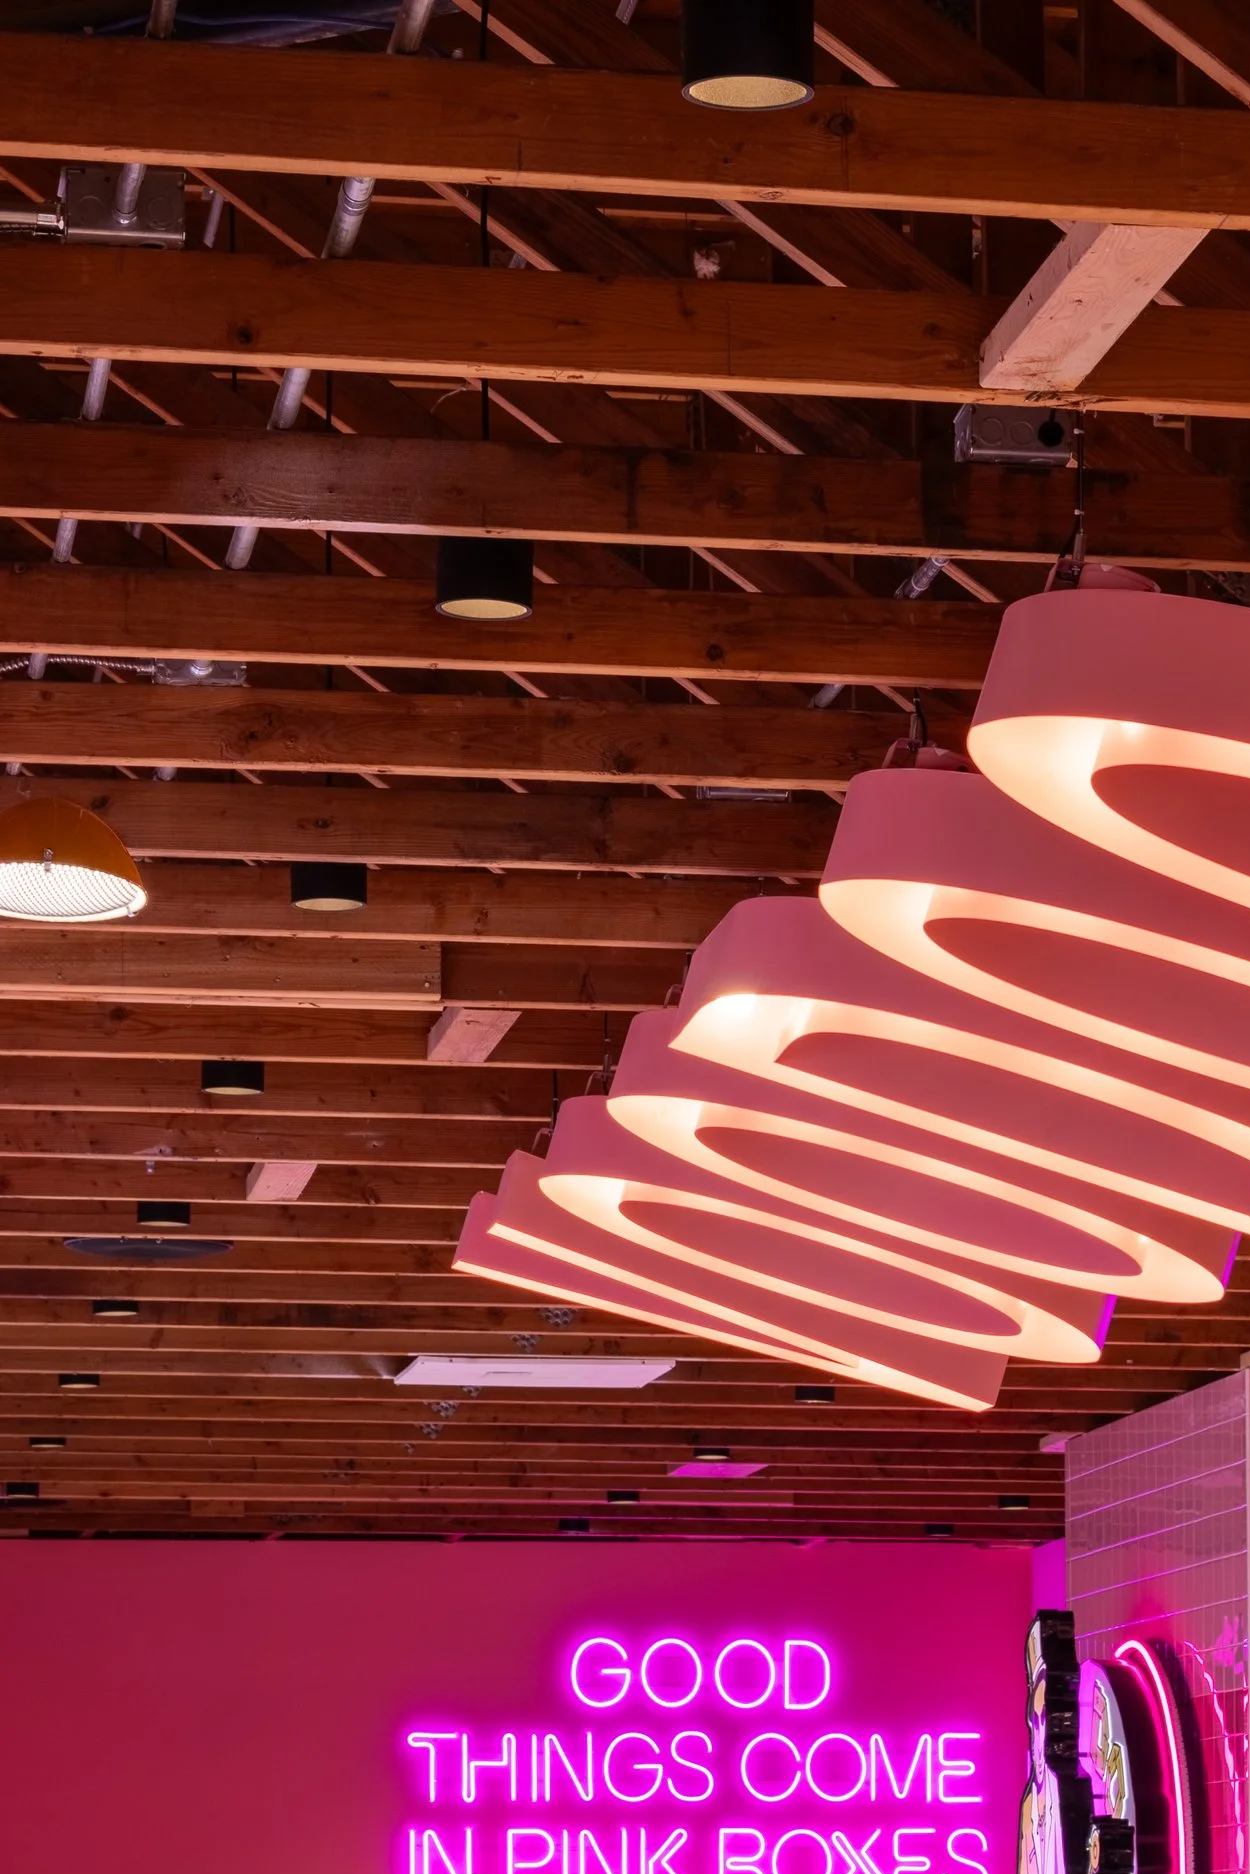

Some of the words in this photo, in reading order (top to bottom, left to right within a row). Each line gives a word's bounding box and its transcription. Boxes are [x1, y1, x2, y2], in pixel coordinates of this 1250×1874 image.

[571, 1637, 831, 1710] GOOD
[407, 1731, 714, 1802] THINGS
[740, 1731, 983, 1803] COME
